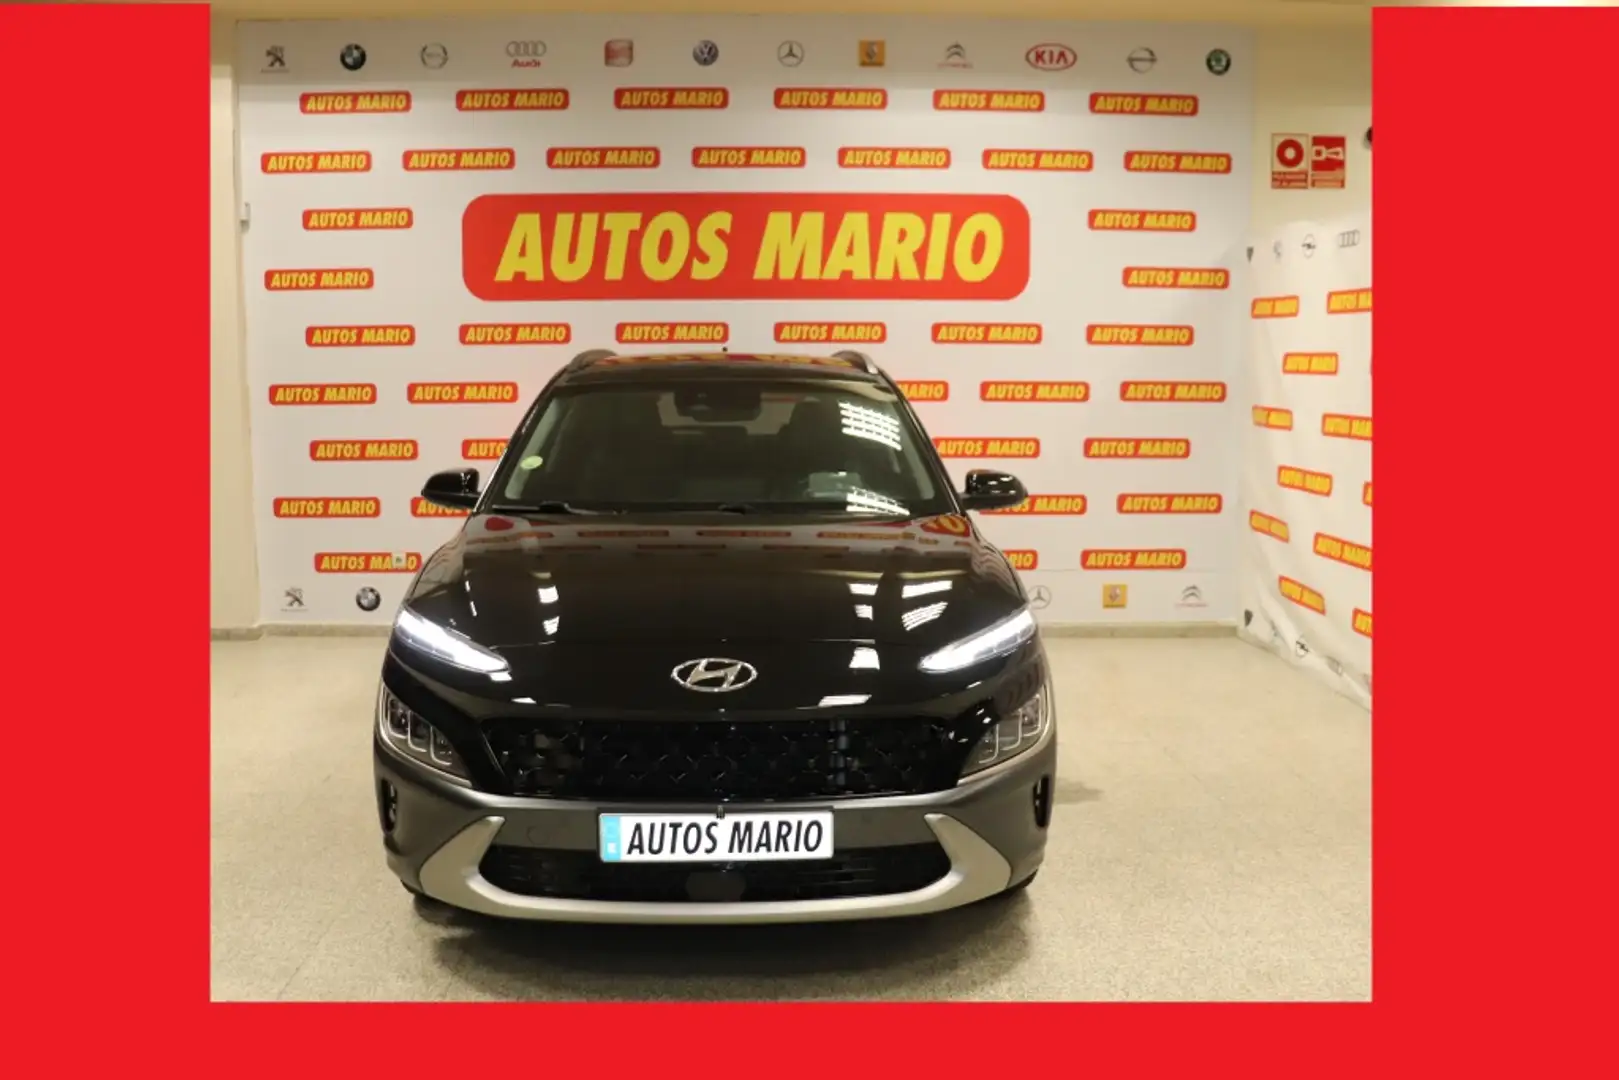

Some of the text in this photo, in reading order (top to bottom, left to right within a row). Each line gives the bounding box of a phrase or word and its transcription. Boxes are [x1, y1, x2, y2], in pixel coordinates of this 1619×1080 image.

[1035, 49, 1068, 64] KIA
[305, 95, 407, 110] AUTOS MARIO
[462, 93, 564, 107] AUTOS MARIO
[621, 91, 723, 105] AUTOS MARIO
[780, 91, 883, 106] AUTOS MARIO
[937, 93, 1041, 108] AUTOS MARIO
[1094, 96, 1194, 112] AUTOS MARIO
[266, 154, 366, 171] AUTOS MARIO
[408, 152, 510, 168] AUTOS MARIO
[553, 150, 655, 165] AUTOS MARIO
[698, 150, 801, 164] AUTOS MARIO
[843, 150, 947, 165] AUTOS MARIO
[987, 152, 1089, 168] AUTOS MARIO
[1130, 154, 1227, 170] AUTOS MARIO
[308, 211, 409, 227] AUTOS MARIO
[1093, 212, 1192, 228] AUTOS MARIO
[495, 211, 1004, 282] AUTOS MARIO
[270, 272, 370, 287] AUTOS MARIO
[1127, 270, 1225, 286] AUTOS MARIO
[311, 328, 411, 344] AUTOS MARIO
[465, 326, 566, 342] AUTOS MARIO
[622, 326, 724, 340] AUTOS MARIO
[779, 325, 882, 340] AUTOS MARIO
[936, 326, 1038, 341] AUTOS MARIO
[1090, 327, 1190, 342] AUTOS MARIO
[274, 387, 372, 402] AUTOS MARIO
[413, 385, 513, 401] AUTOS MARIO
[985, 384, 1086, 399] AUTOS MARIO
[1124, 384, 1223, 398] AUTOS MARIO
[315, 443, 413, 458] AUTOS MARIO
[936, 440, 1036, 456] AUTOS MARIO
[1088, 441, 1187, 456] AUTOS MARIO
[279, 500, 376, 515] AUTOS MARIO
[1034, 498, 1083, 512] MARIO
[1121, 497, 1218, 511] AUTOS MARIO
[320, 556, 417, 570] AUTOS MAO
[1086, 552, 1183, 567] AUTOS MARIO
[627, 820, 823, 855] AUTOS MARIO
